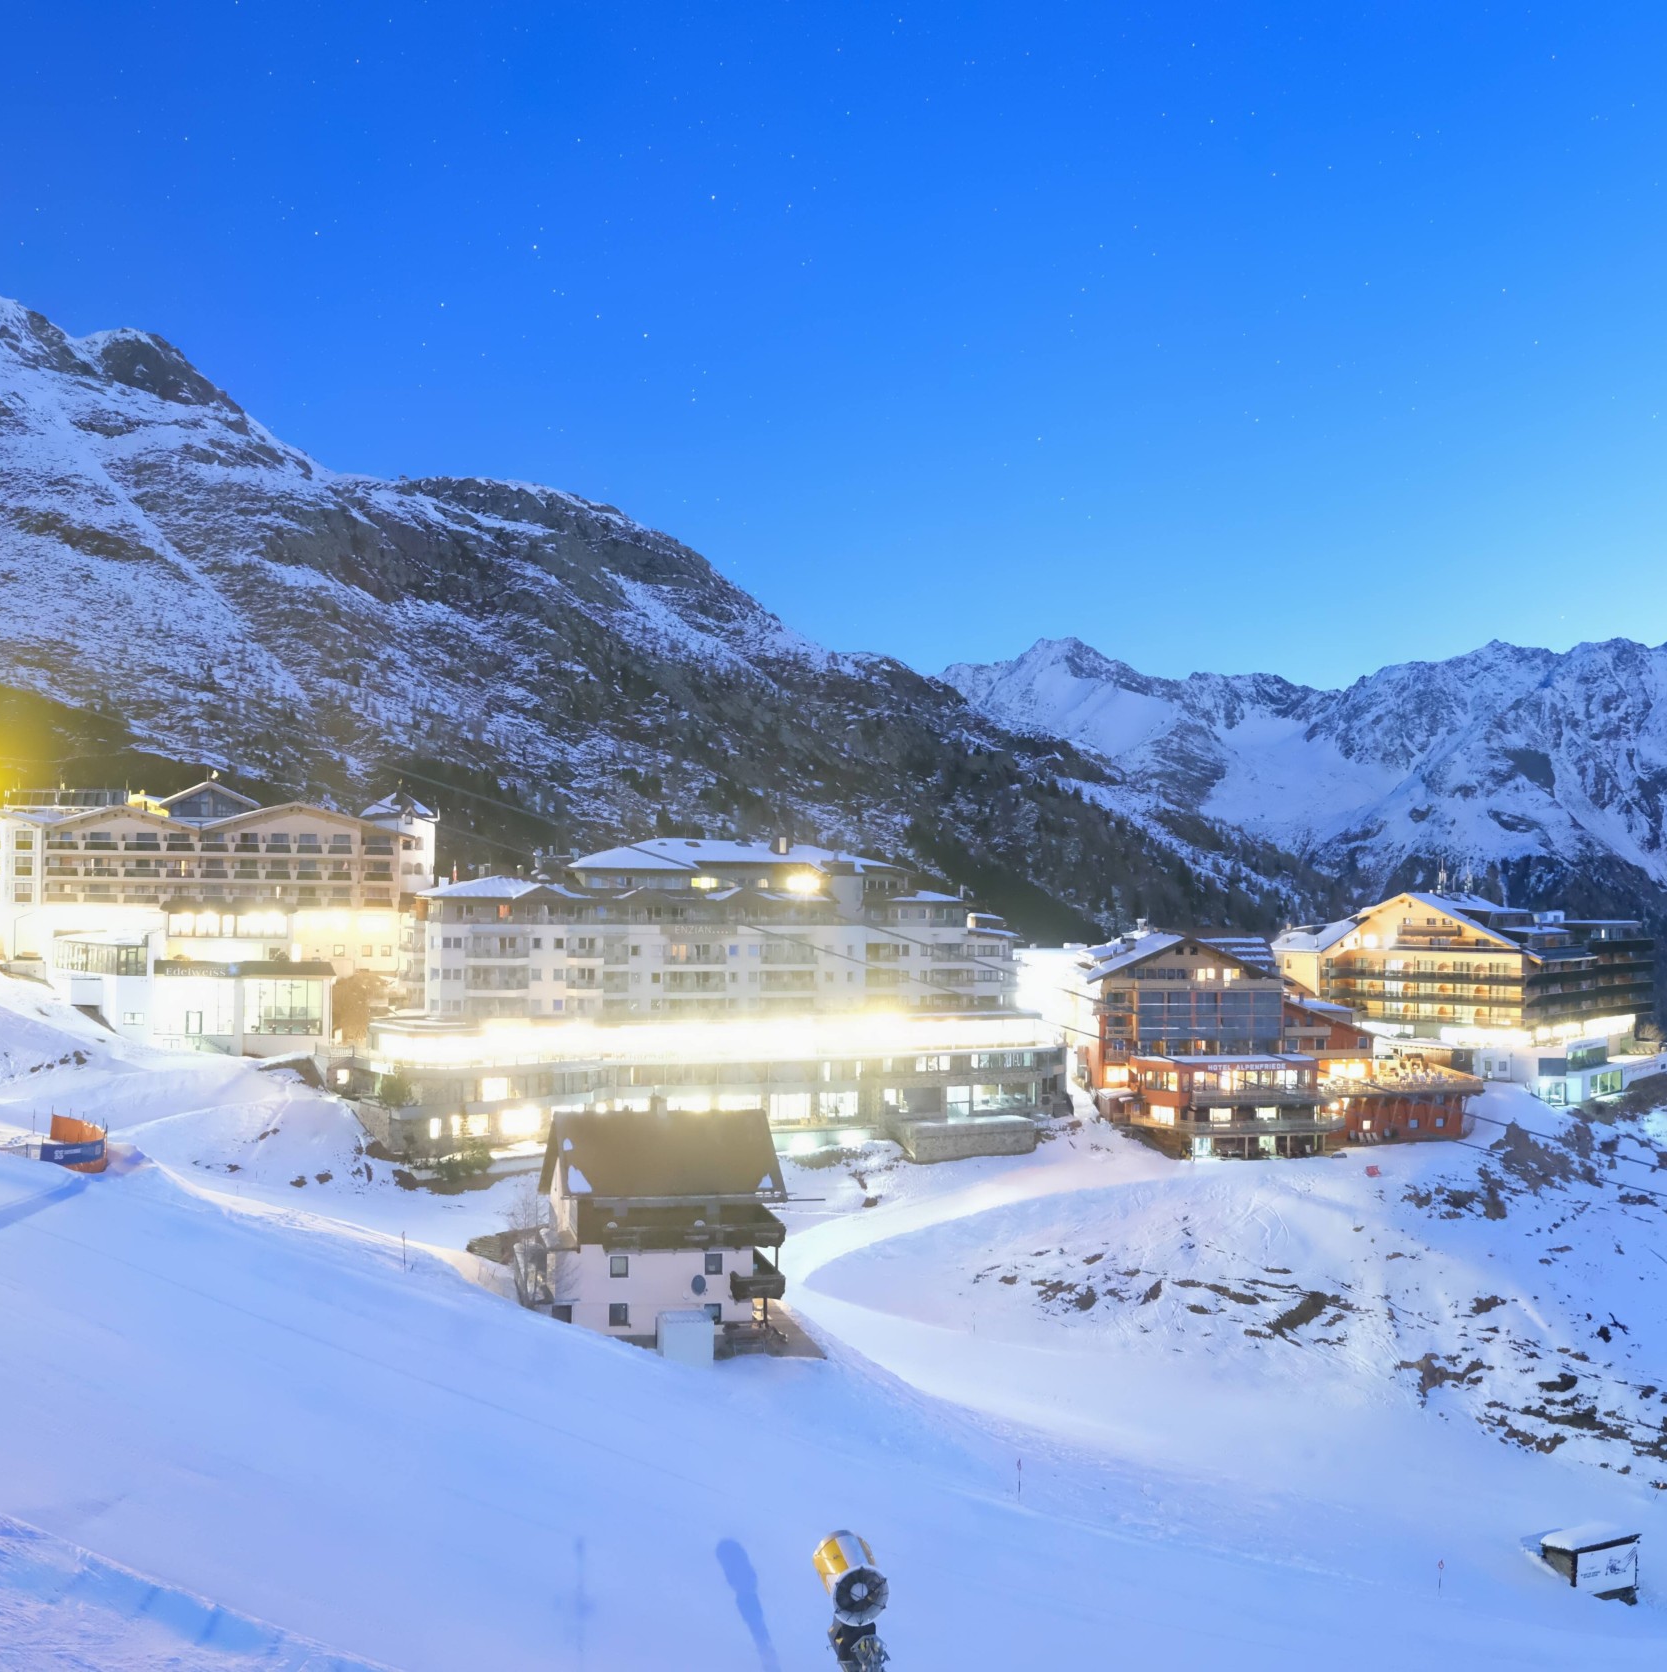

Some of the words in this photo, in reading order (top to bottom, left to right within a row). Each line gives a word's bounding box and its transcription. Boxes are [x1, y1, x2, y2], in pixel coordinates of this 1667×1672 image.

[674, 925, 712, 935] ENZIAN
[166, 967, 226, 977] Edelweiss
[1235, 1063, 1287, 1071] ALPENFRIEDE
